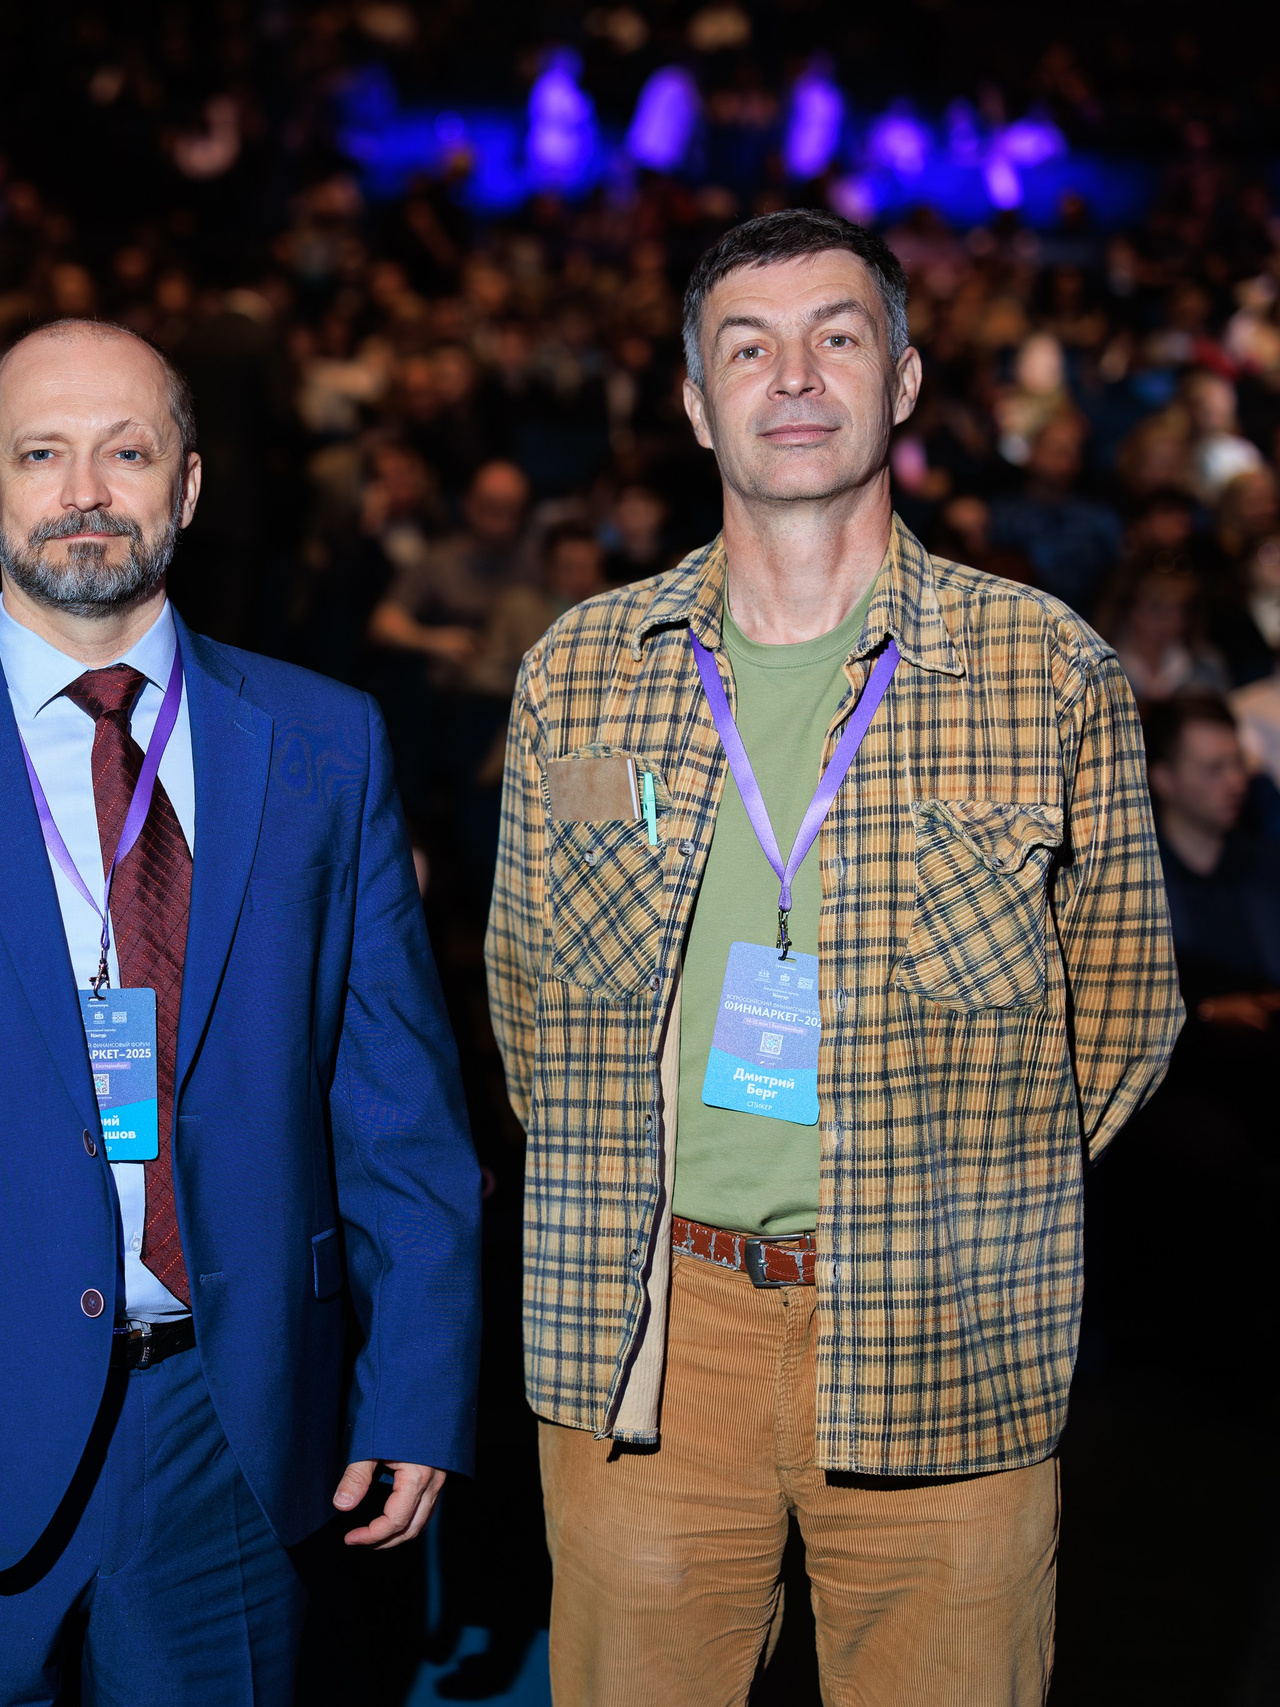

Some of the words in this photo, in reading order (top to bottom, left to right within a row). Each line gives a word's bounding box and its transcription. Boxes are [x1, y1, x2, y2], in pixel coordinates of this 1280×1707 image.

[733, 1067, 795, 1090] Дмитрий
[746, 1082, 778, 1101] Берг
[746, 1100, 773, 1111] СПИКЕР
